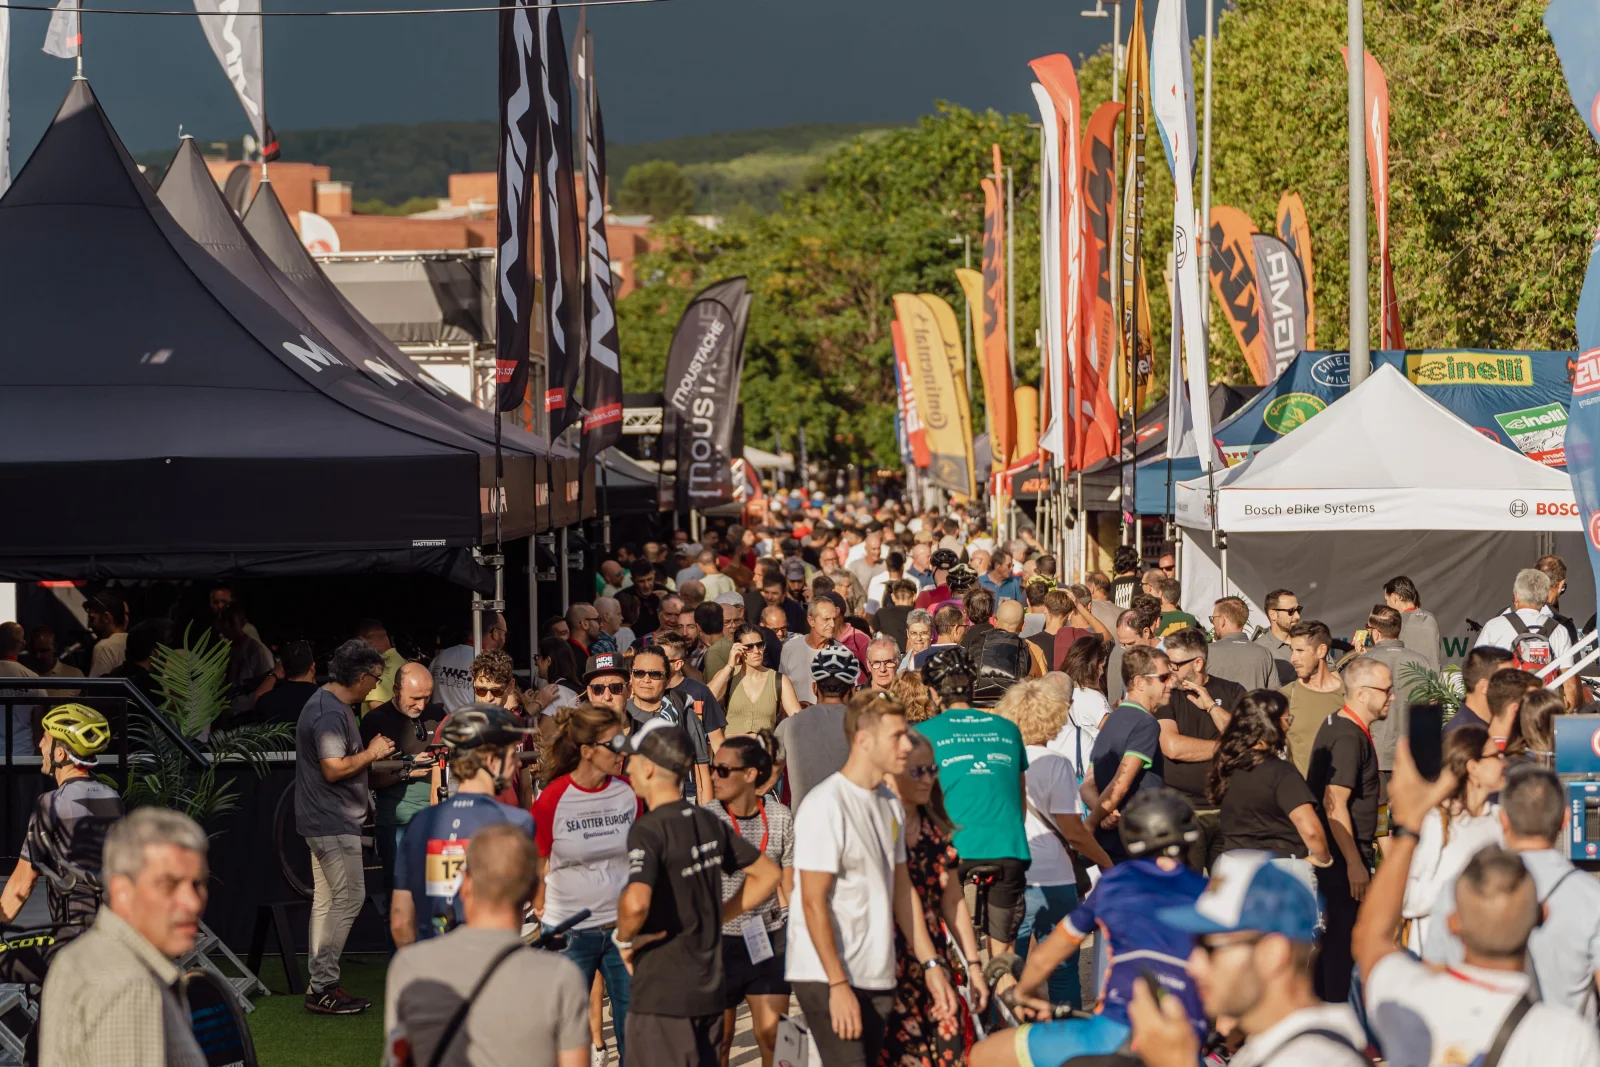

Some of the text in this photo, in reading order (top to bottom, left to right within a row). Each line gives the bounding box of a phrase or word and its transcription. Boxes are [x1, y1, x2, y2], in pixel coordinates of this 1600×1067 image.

[671, 318, 725, 411] MOUSTACHE
[1318, 356, 1350, 374] CINEL
[1244, 503, 1376, 515] Bosch eBike Systems
[1536, 503, 1580, 516] BOSC
[566, 820, 581, 832] SEA
[581, 816, 605, 829] OTTER
